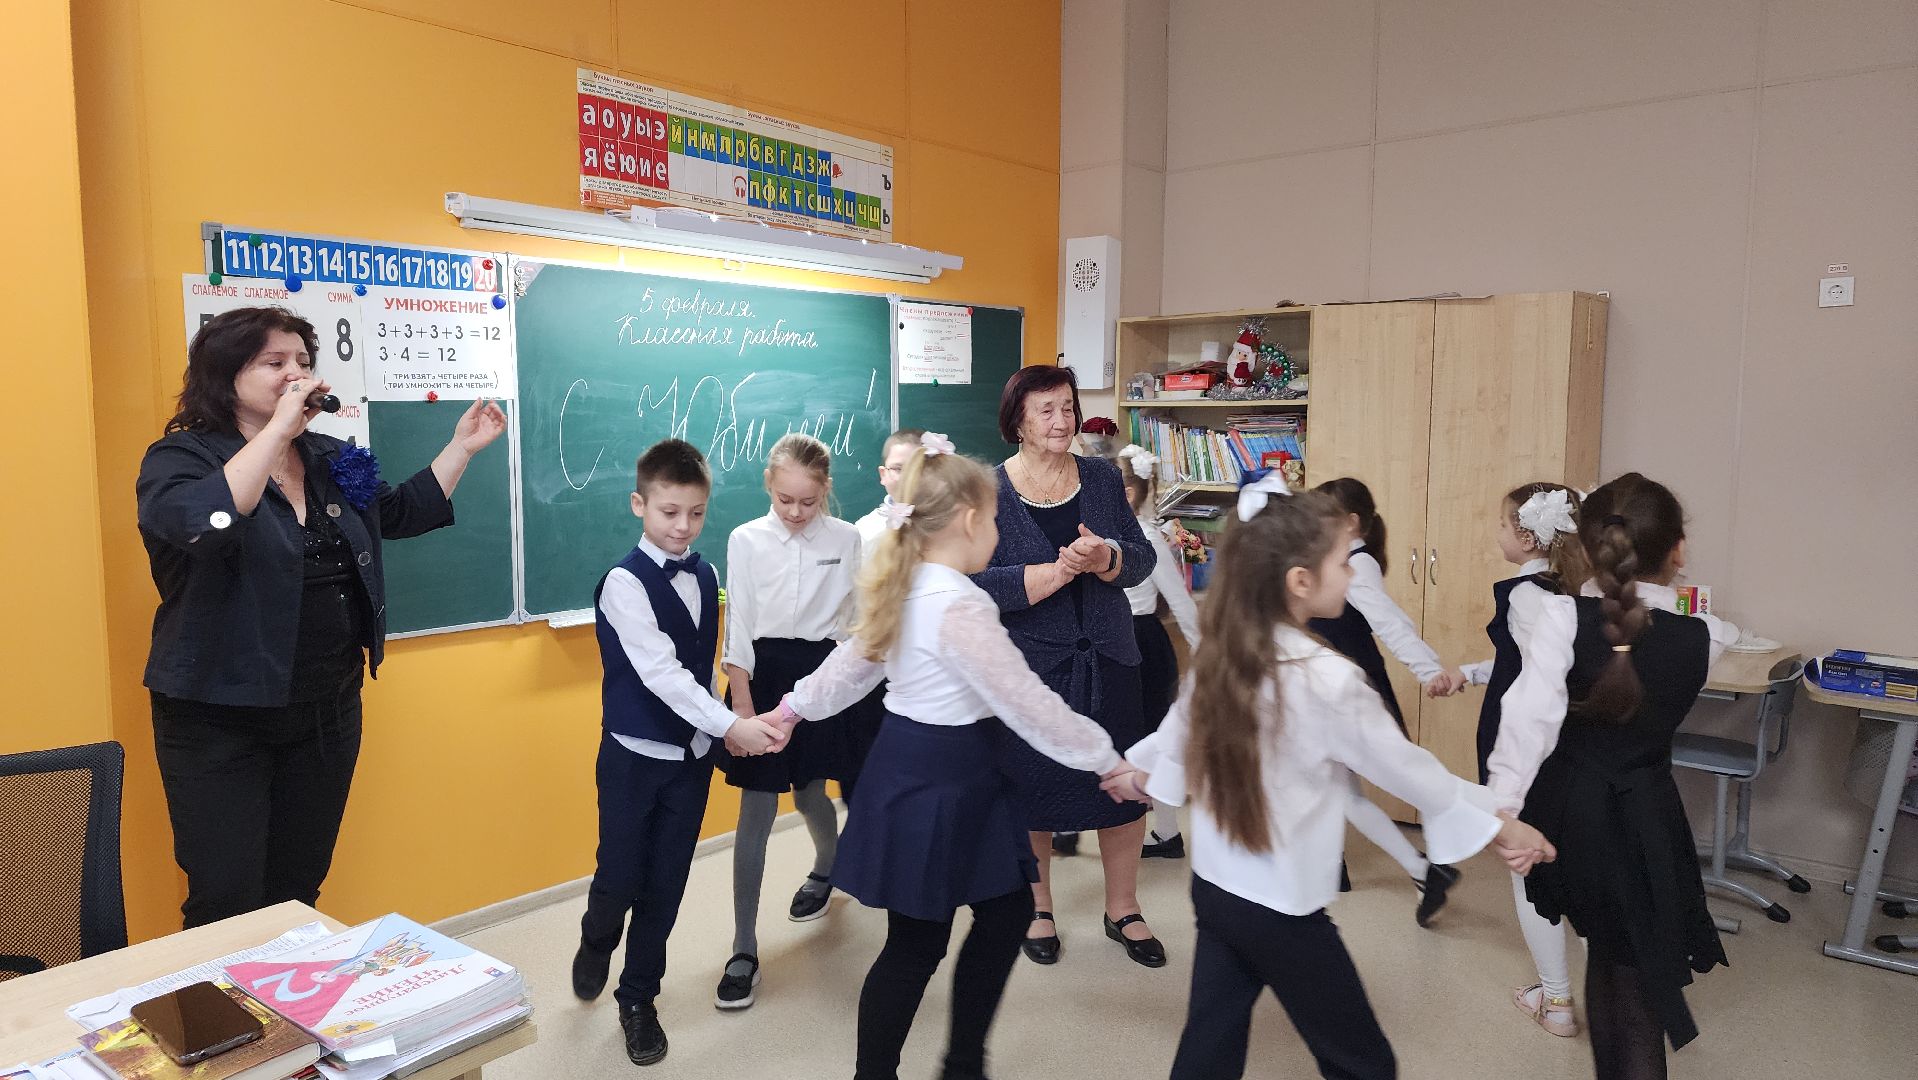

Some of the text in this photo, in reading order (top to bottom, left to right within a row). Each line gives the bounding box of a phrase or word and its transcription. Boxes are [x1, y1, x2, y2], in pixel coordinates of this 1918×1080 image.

[228, 239, 496, 292] 11 12 13 14 15 16 17 18 19 20
[192, 283, 289, 300] СЛАГАЕМОЕ СЛАГАЕМОЕ
[327, 291, 353, 304] СУММА
[384, 297, 488, 314] УМНОЖЕНИЕ
[640, 287, 655, 313] 5
[336, 318, 354, 361] 8
[614, 313, 736, 346] Классная
[438, 347, 457, 361] 12
[559, 378, 605, 490] С
[251, 967, 321, 1002] 2
[343, 963, 466, 1017] Литературное
